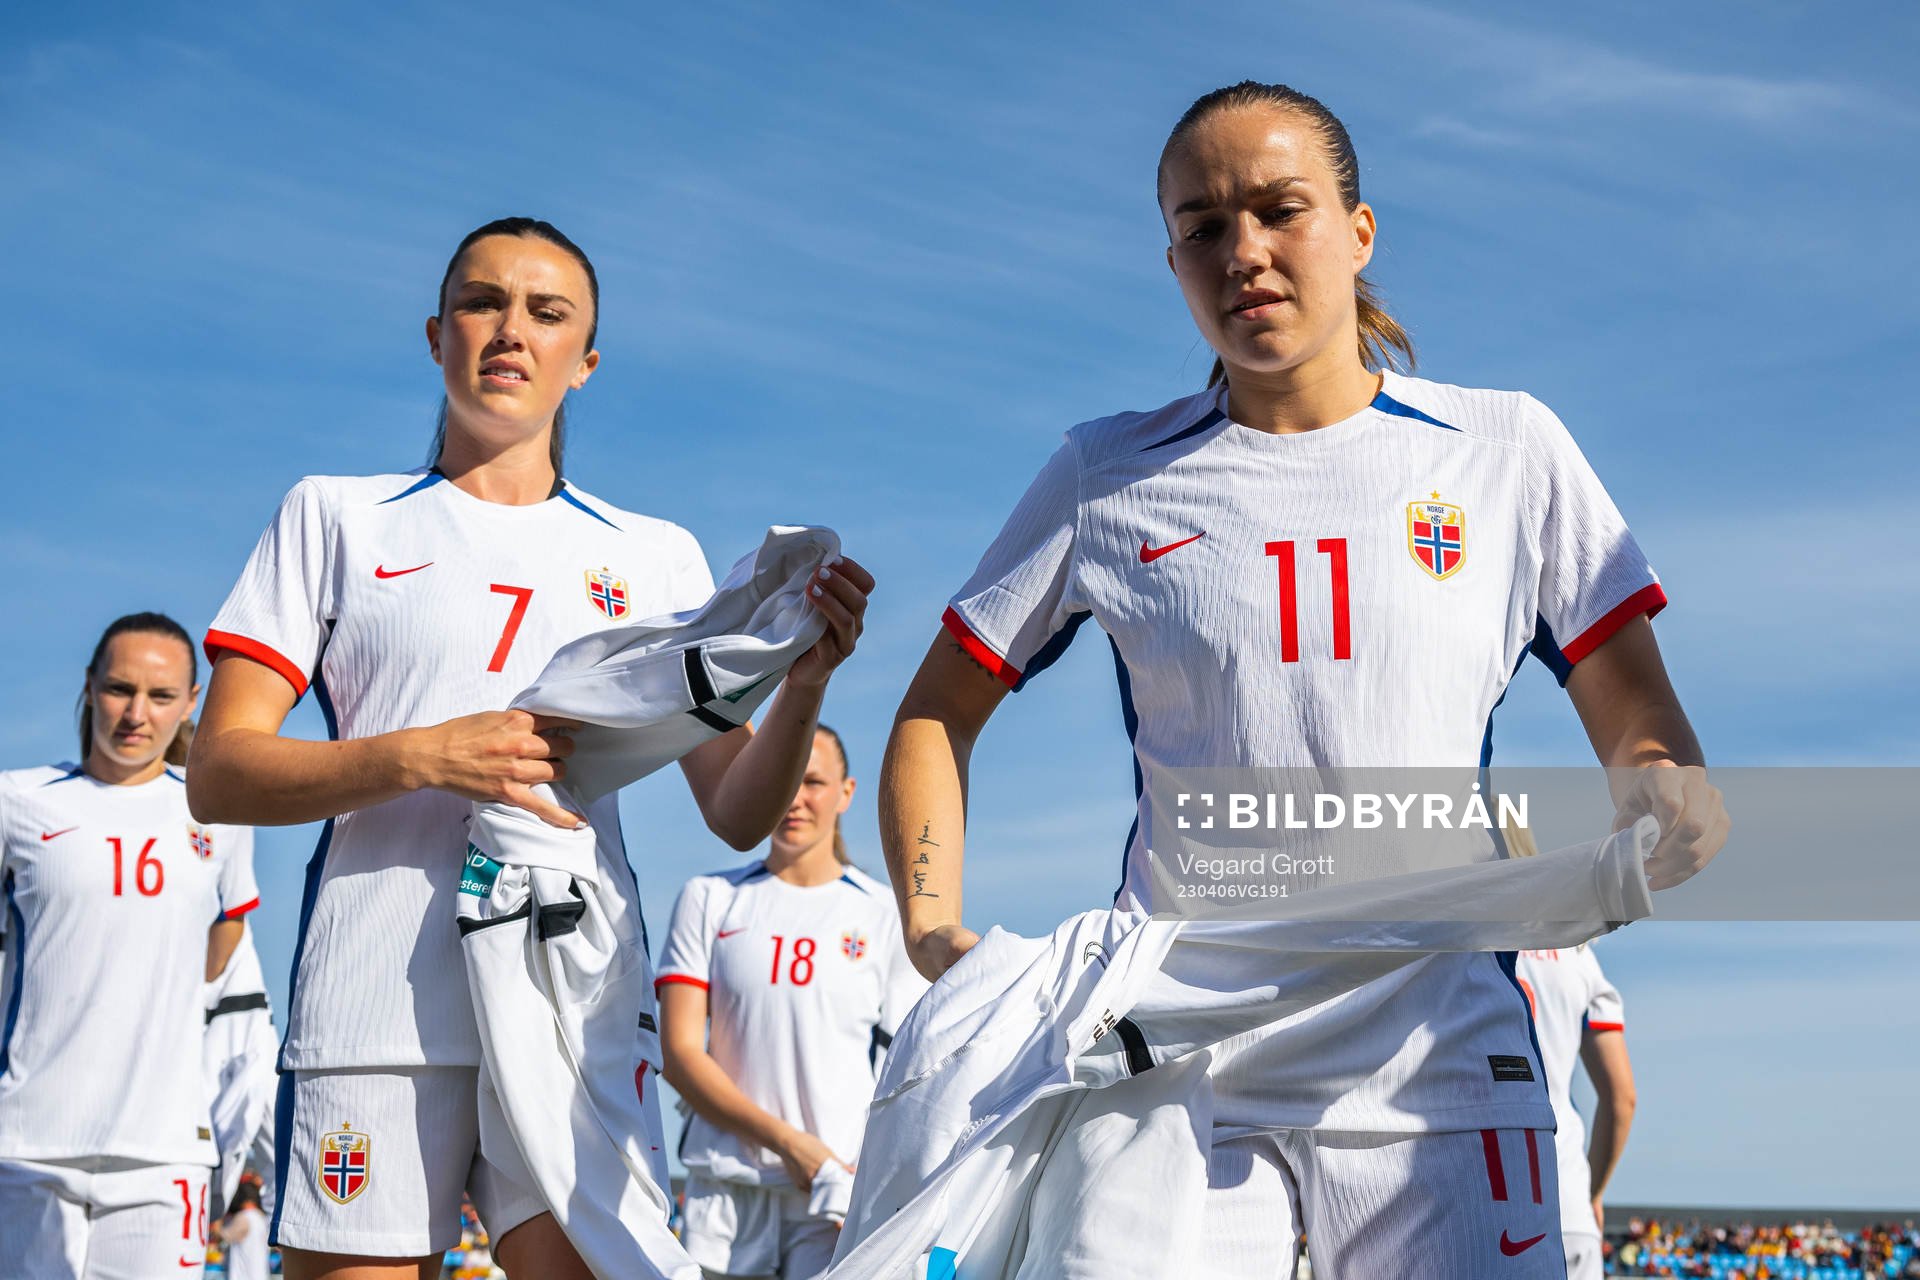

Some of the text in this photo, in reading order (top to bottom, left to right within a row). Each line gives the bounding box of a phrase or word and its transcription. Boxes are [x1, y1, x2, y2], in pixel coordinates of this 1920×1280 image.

[1426, 504, 1450, 515] NORGE
[487, 583, 534, 673] 7
[1264, 538, 1351, 663] 11
[105, 836, 164, 897] 16
[770, 935, 816, 986] 18
